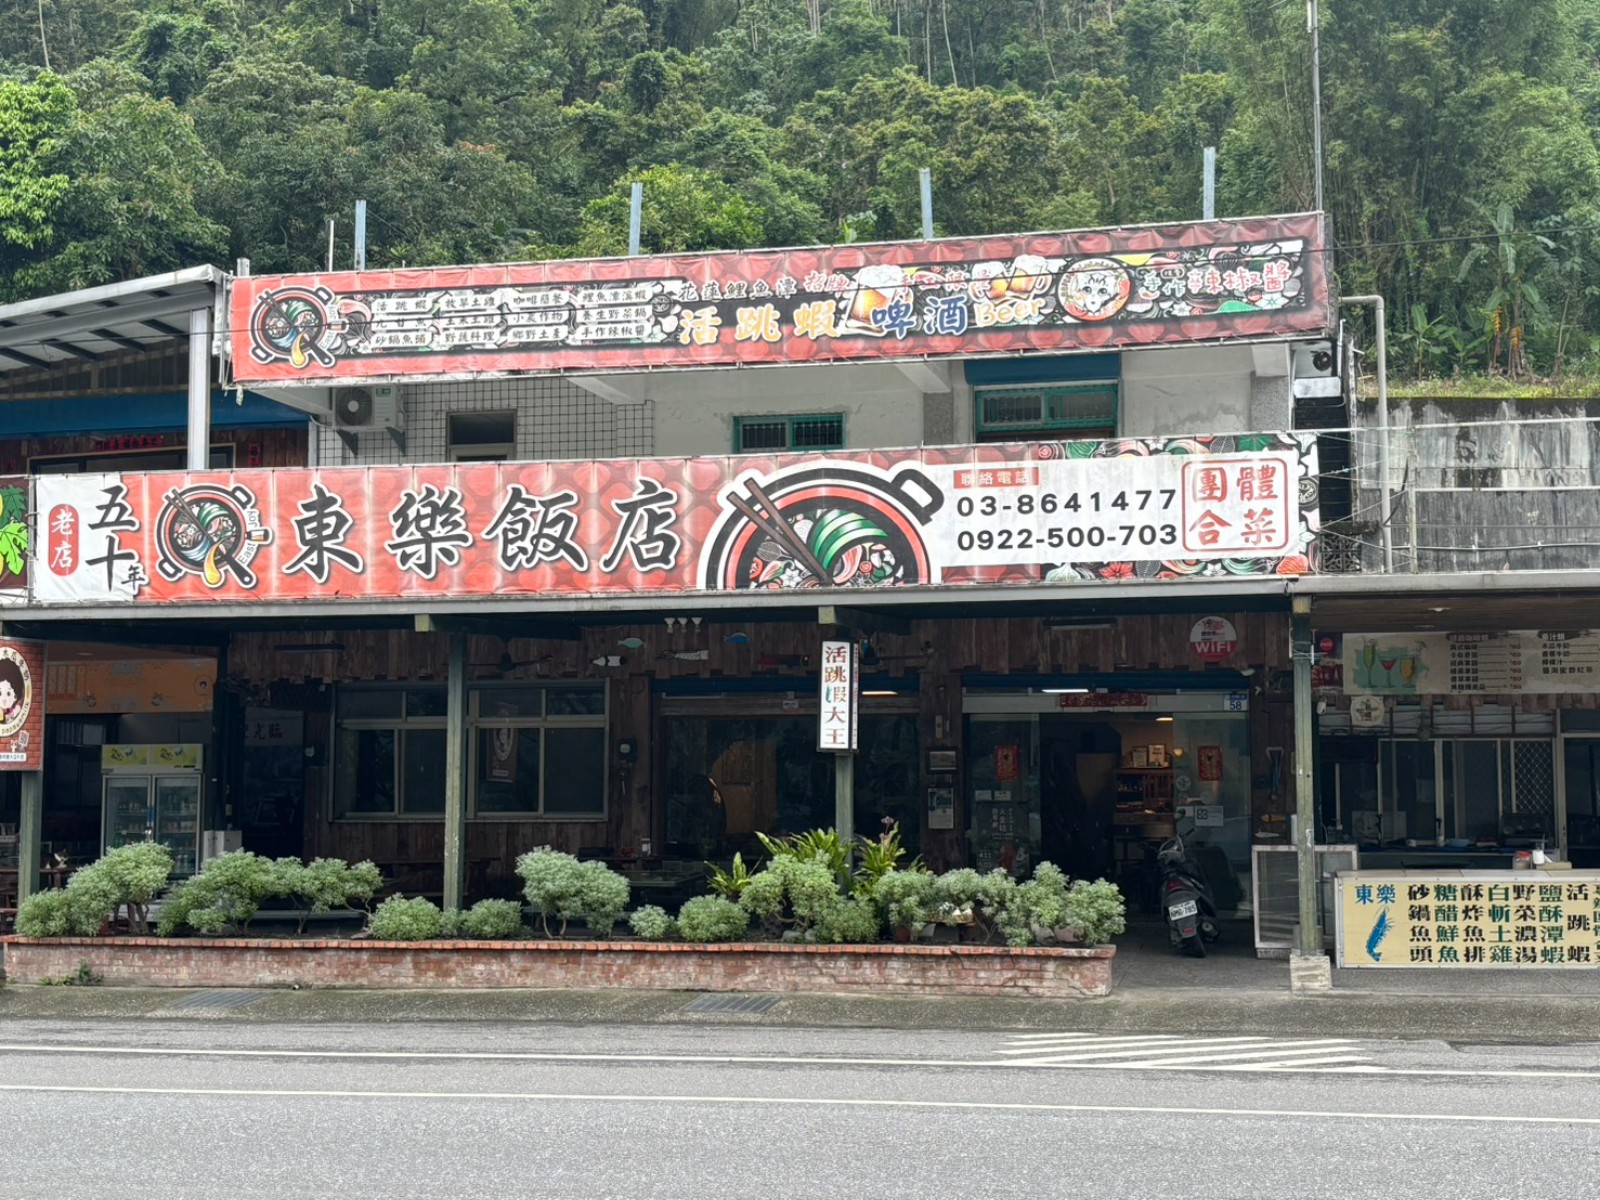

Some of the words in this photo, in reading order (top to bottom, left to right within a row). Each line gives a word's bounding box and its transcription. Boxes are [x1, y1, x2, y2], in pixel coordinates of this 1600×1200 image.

[680, 300, 839, 345] 活跳蝦
[871, 295, 968, 340] 啤酒
[50, 510, 76, 569] 老店
[286, 481, 678, 580] 東樂飯店
[956, 489, 1177, 518] 03-8641477
[957, 524, 1177, 551] 0922-500-703
[1194, 640, 1232, 653] WIFI
[1229, 700, 1242, 711] 58
[1355, 884, 1396, 905] 東樂
[1407, 884, 1433, 963] 砂鍋魚頭
[1434, 884, 1460, 963] 糖醋鮮魚
[1460, 884, 1486, 963] 酥炸魚排
[1487, 884, 1513, 963] 白斬土雞
[1513, 884, 1537, 963] 野菜濃湯
[1538, 884, 1565, 963] 鹽酥潭蝦
[1566, 884, 1591, 963] 活跳蝦
